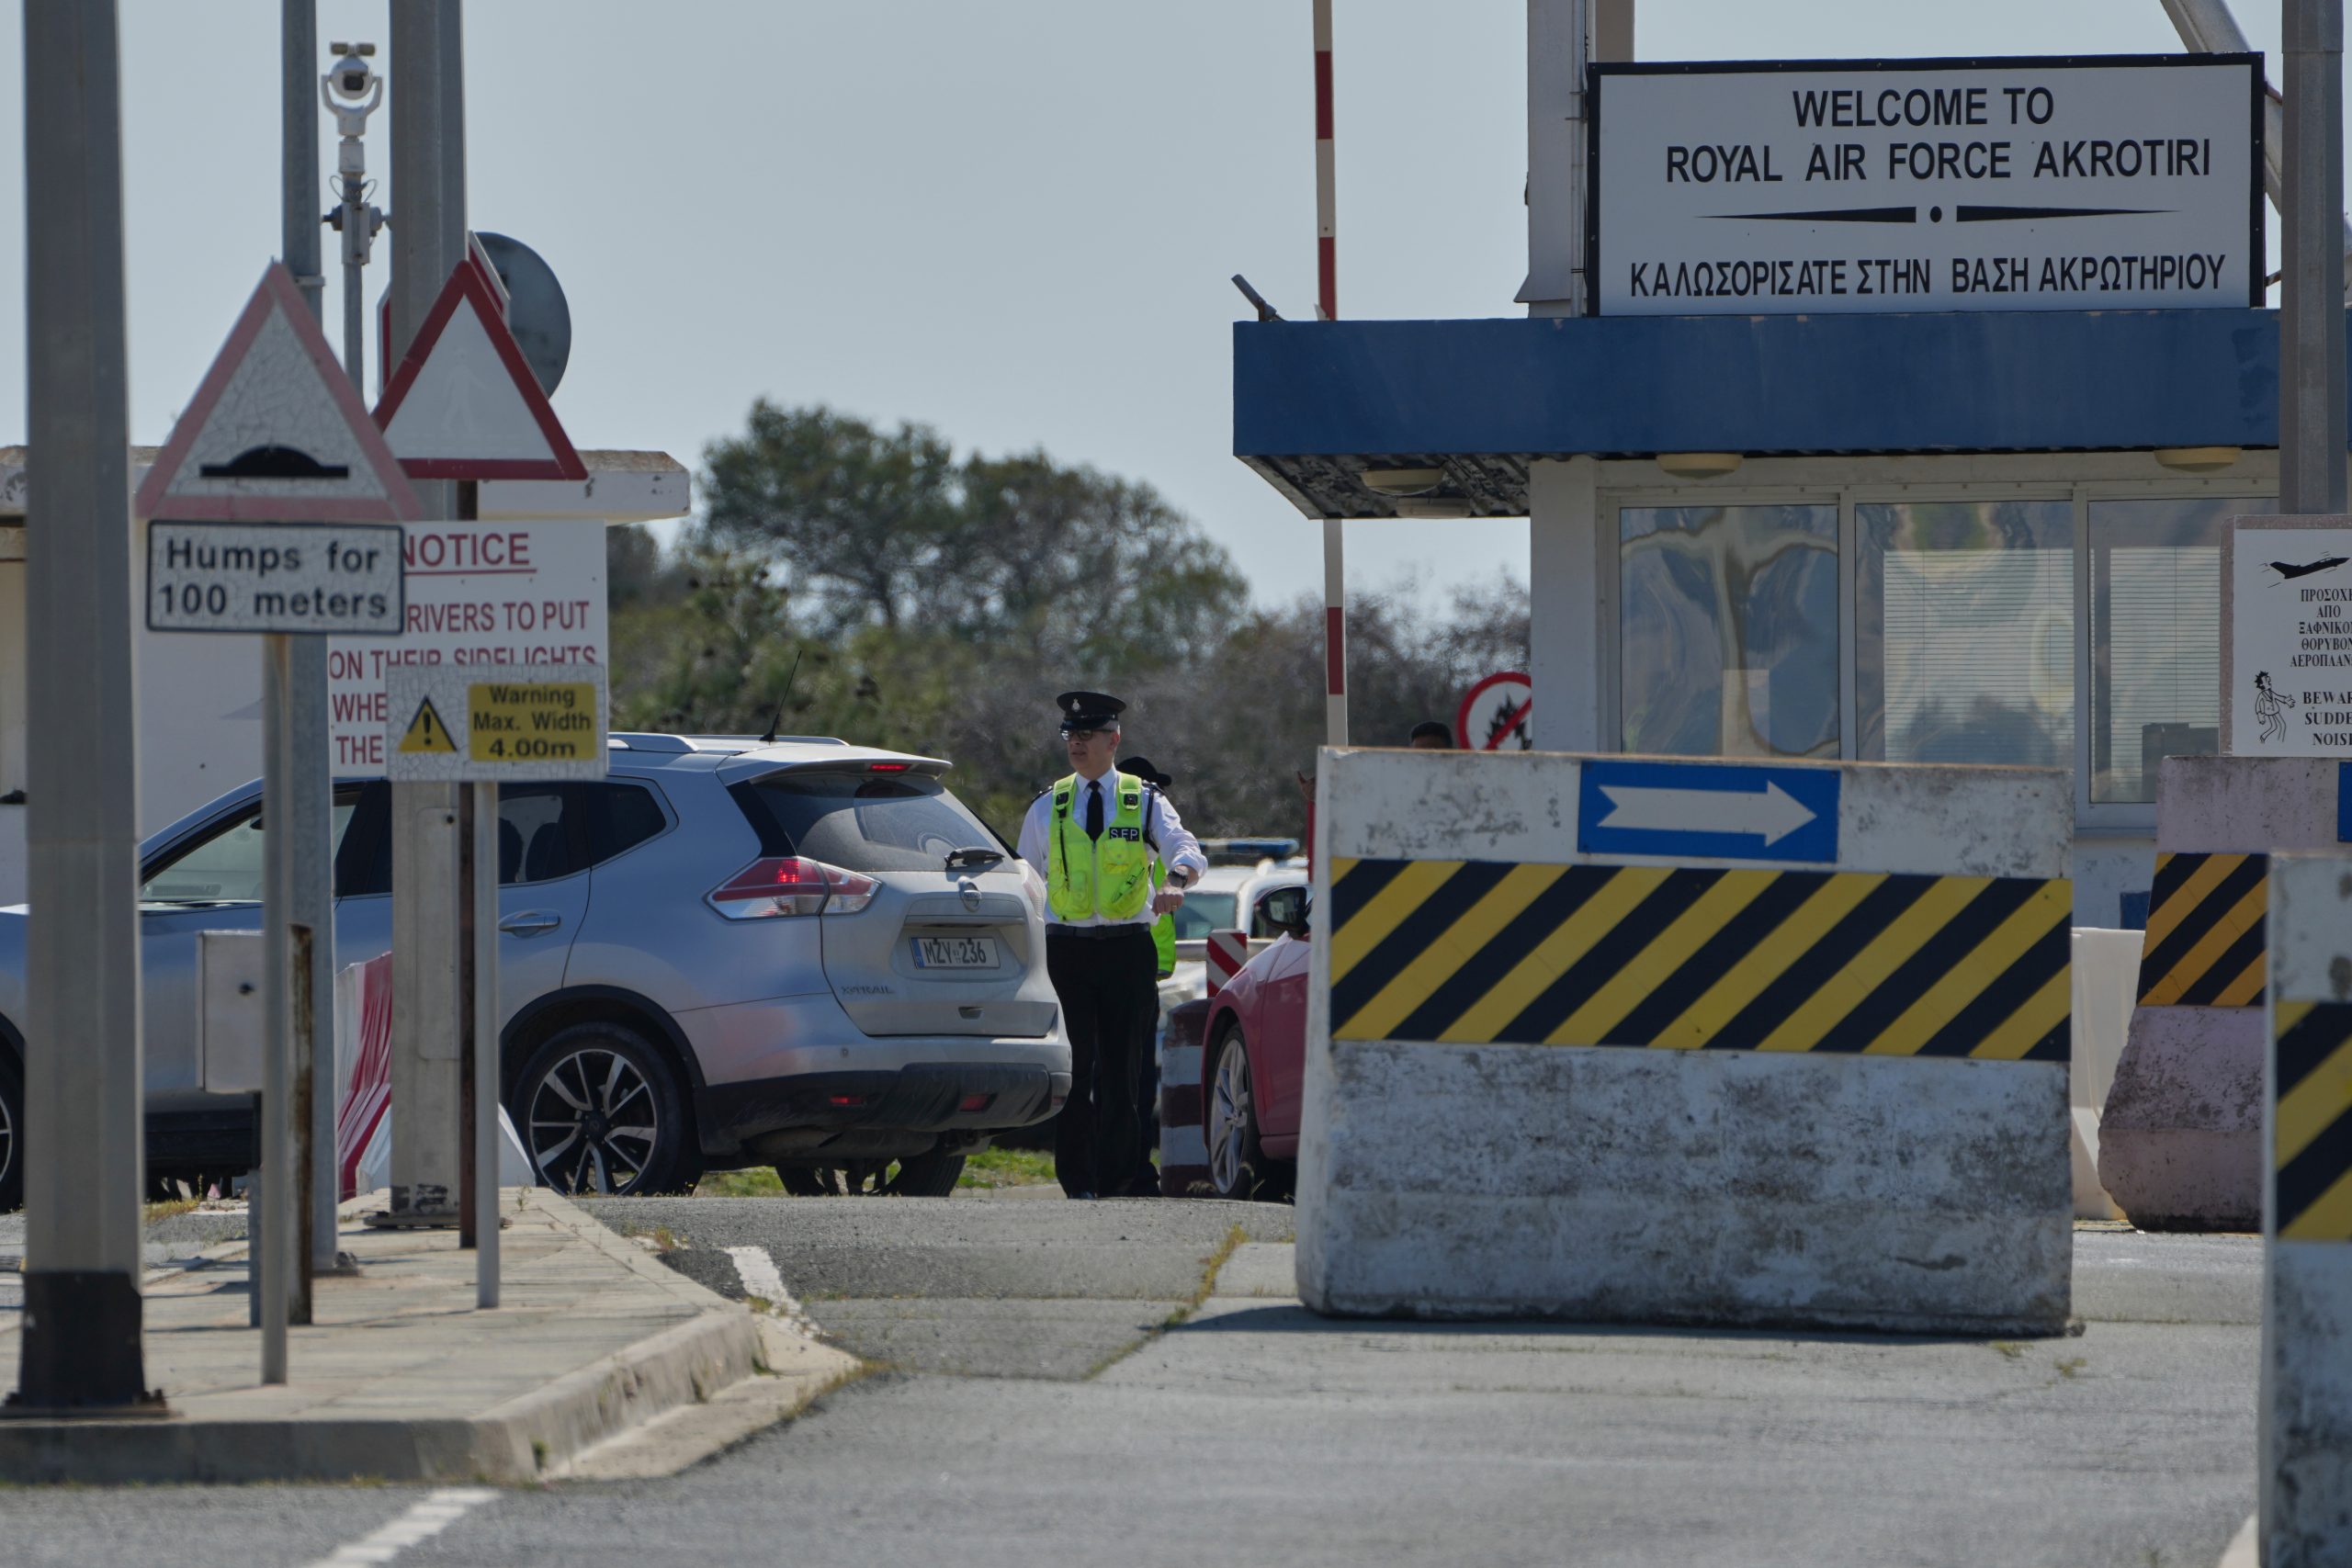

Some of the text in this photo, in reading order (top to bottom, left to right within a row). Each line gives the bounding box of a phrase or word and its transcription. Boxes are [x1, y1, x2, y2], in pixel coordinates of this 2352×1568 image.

[1792, 86, 2053, 127] WELCOME TO
[1667, 139, 2210, 183] ROYAL AIR FORCE AKROTIRI
[1631, 254, 2225, 297] ΚΑΛΩΣΟΡΙΣΑΤΕ ΣΤΗΝ ΒΑΣΗ ΑΚΡΩΤΗΡΙΟΥ
[166, 537, 379, 578] Humps for
[159, 583, 387, 618] 100 meters
[2316, 604, 2341, 618] ΑΠΟ
[407, 601, 590, 633] RIVERS TO PUT
[2299, 621, 2352, 635] ΞΑΦΝΙΚΟ
[329, 650, 363, 680] ON
[2290, 653, 2352, 668] ΑΕΡΟΠΛΑΝ
[333, 693, 388, 722] WHE
[489, 686, 575, 708] Warning
[474, 711, 591, 731] Max. Width
[2304, 711, 2352, 725] SUDDE
[335, 735, 383, 764] THE
[488, 738, 576, 758] 4.00m
[958, 941, 987, 964] 236
